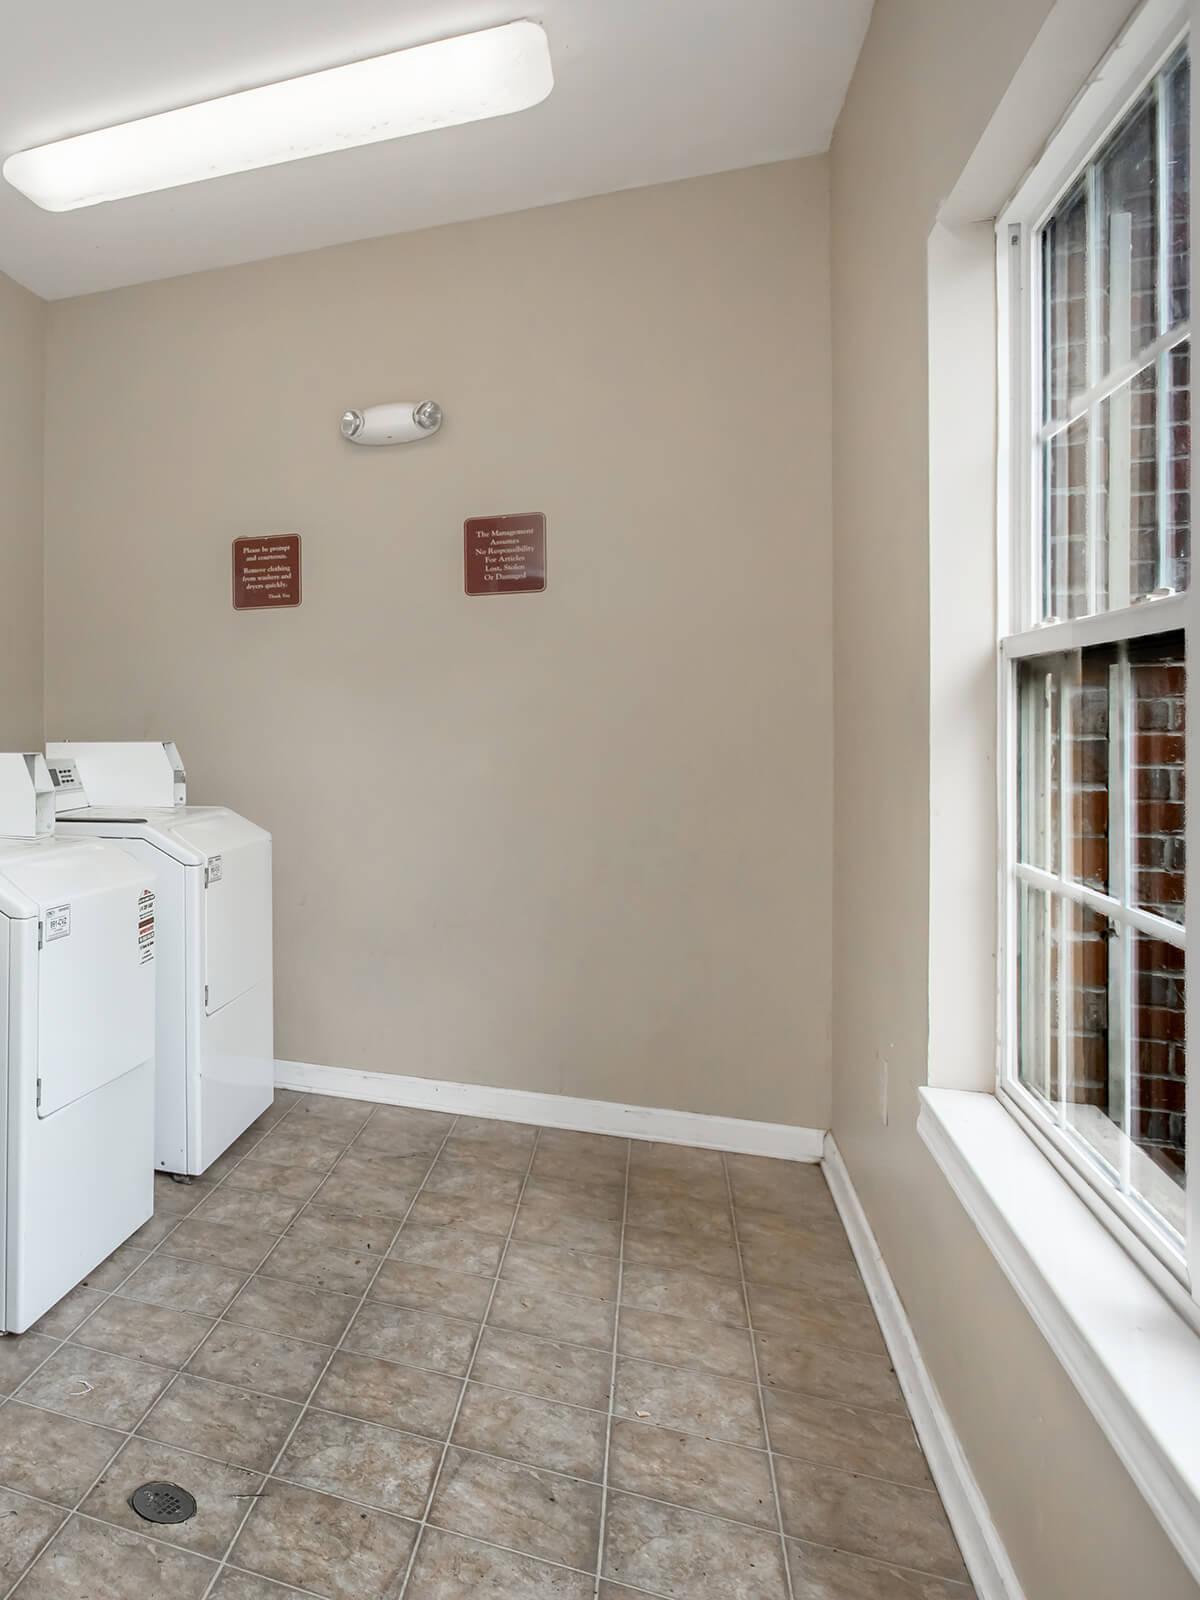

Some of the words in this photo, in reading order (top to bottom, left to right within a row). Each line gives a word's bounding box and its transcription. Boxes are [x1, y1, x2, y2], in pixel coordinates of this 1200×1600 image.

[476, 530, 489, 538] The
[491, 528, 534, 537] Management
[488, 545, 535, 555] Responsibility
[267, 565, 291, 573] clothing
[503, 563, 525, 571] Stolen
[495, 571, 527, 581] Damaged
